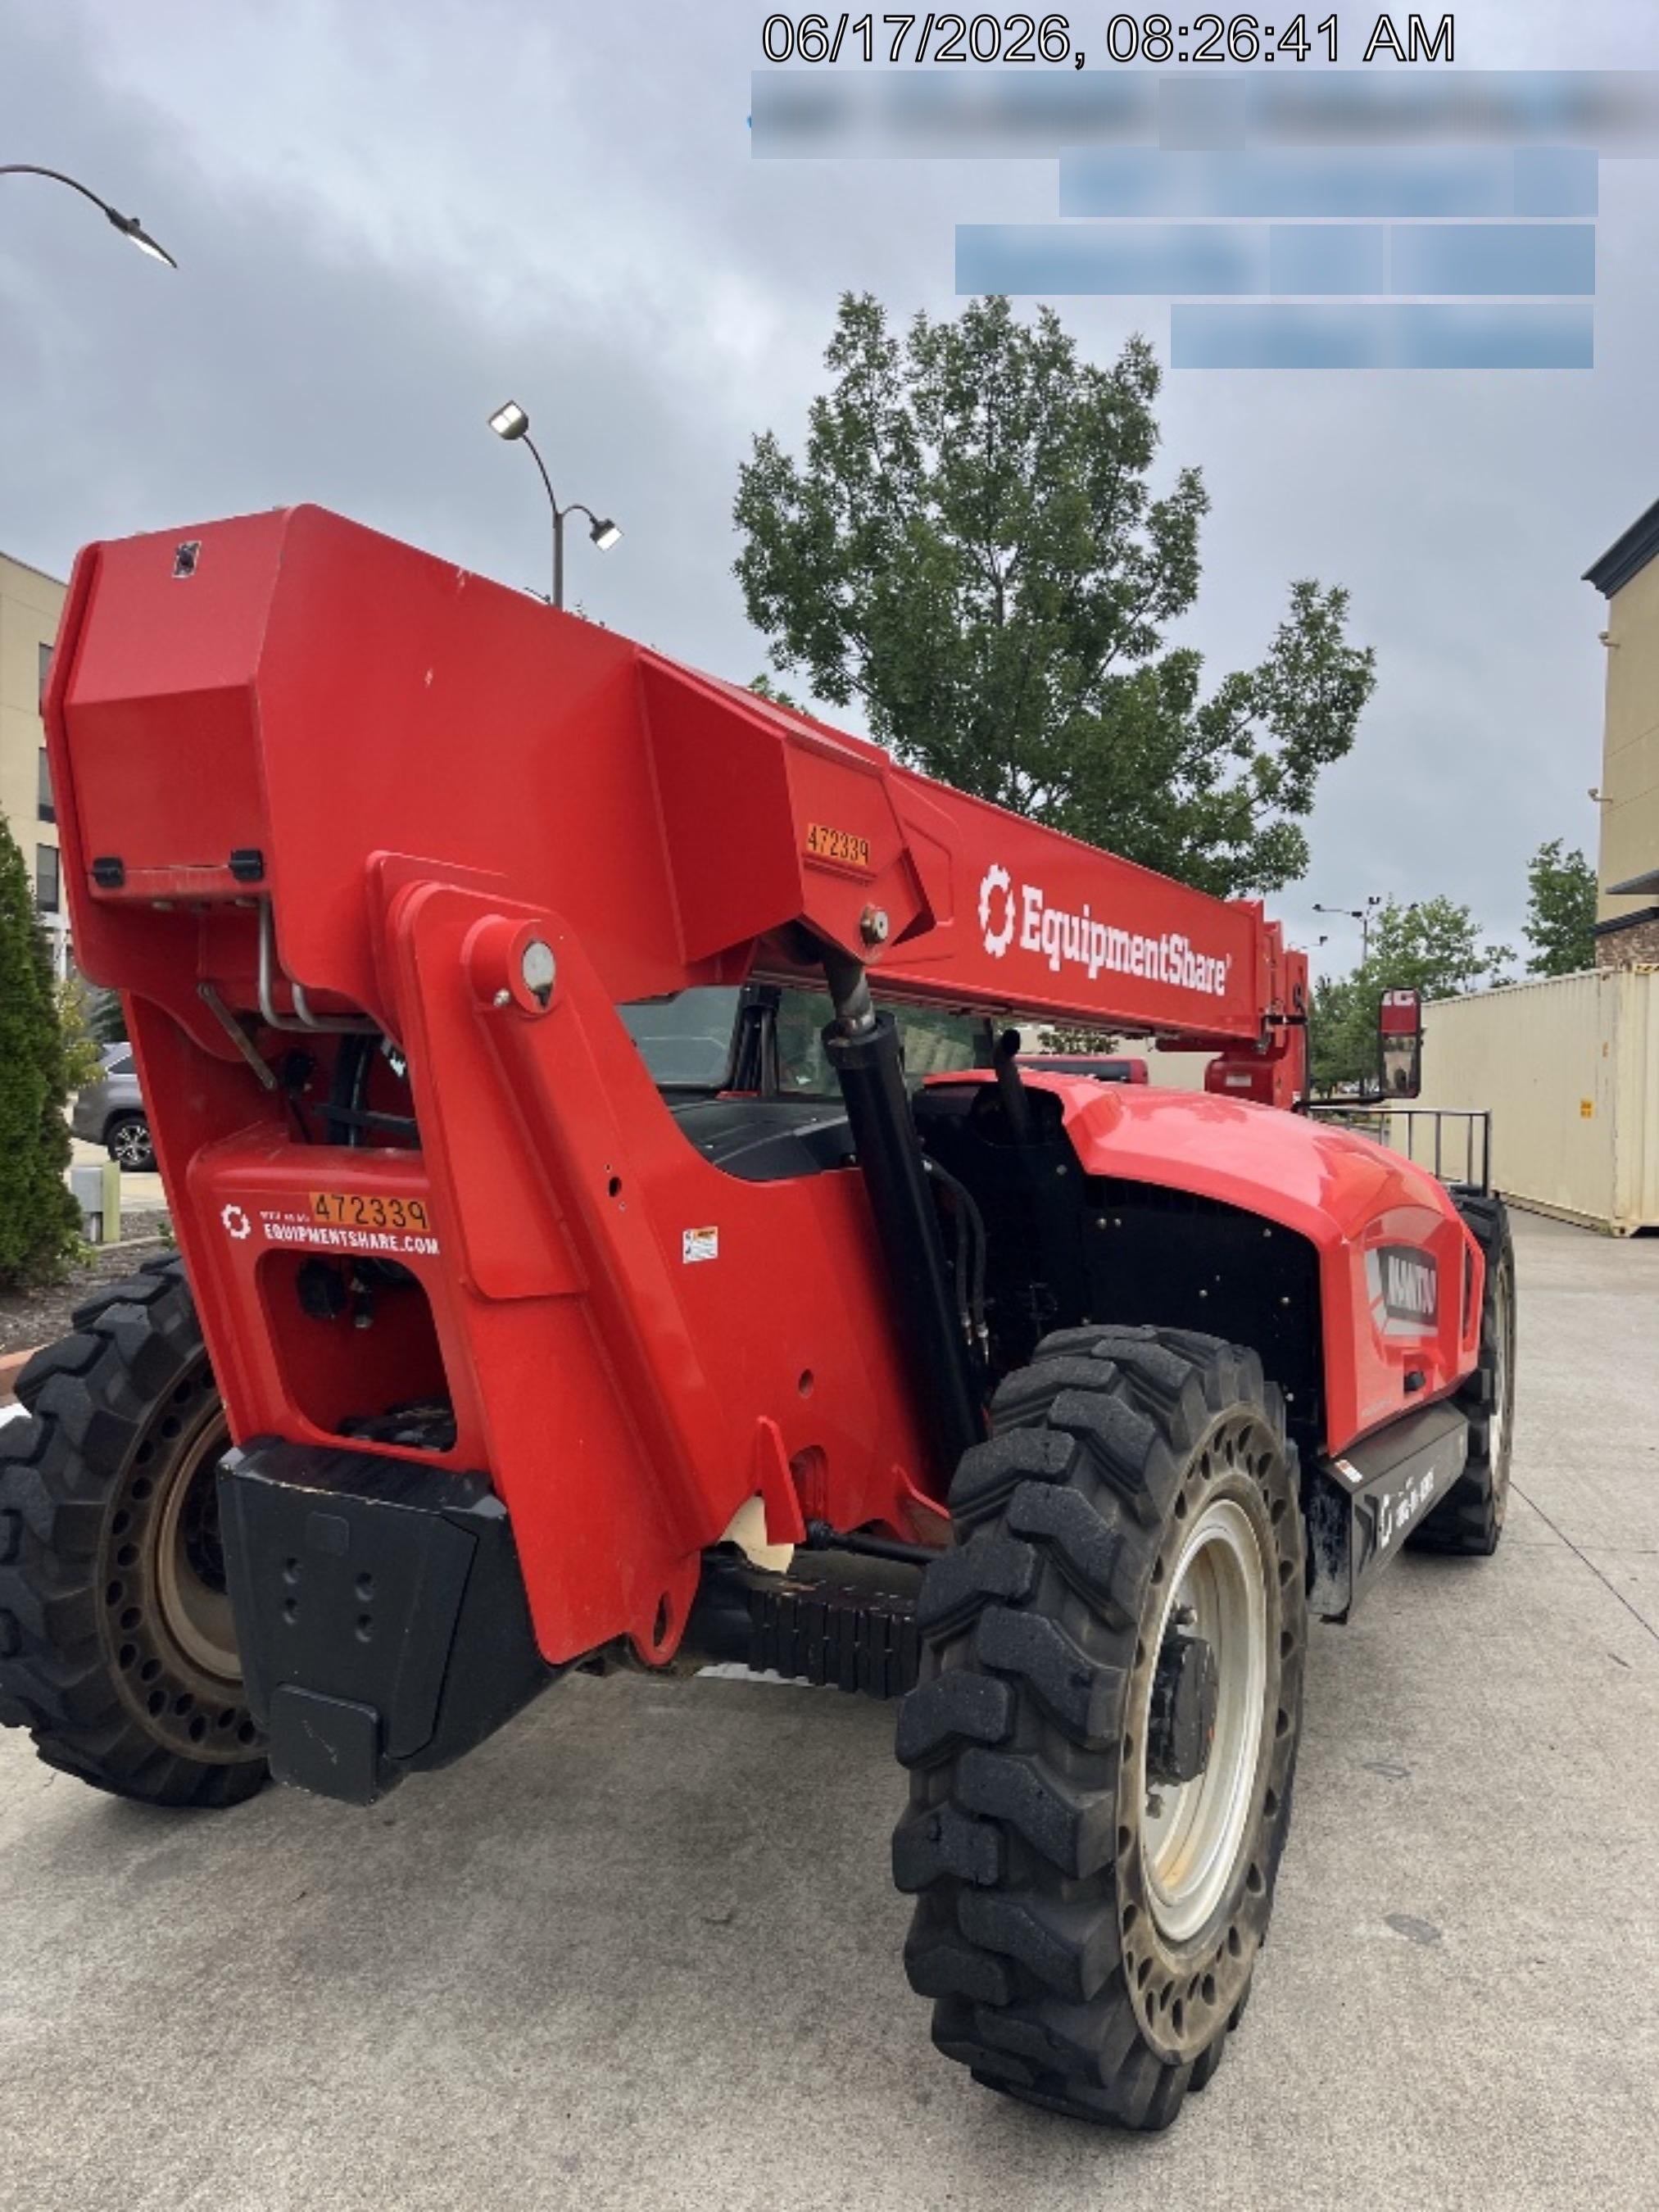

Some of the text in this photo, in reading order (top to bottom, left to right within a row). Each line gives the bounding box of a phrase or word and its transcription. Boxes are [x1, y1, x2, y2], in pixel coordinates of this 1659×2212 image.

[808, 825, 868, 863] 472339
[315, 1194, 428, 1229] 472339
[264, 1223, 440, 1254] EQUIPMENTSHARE.COM
